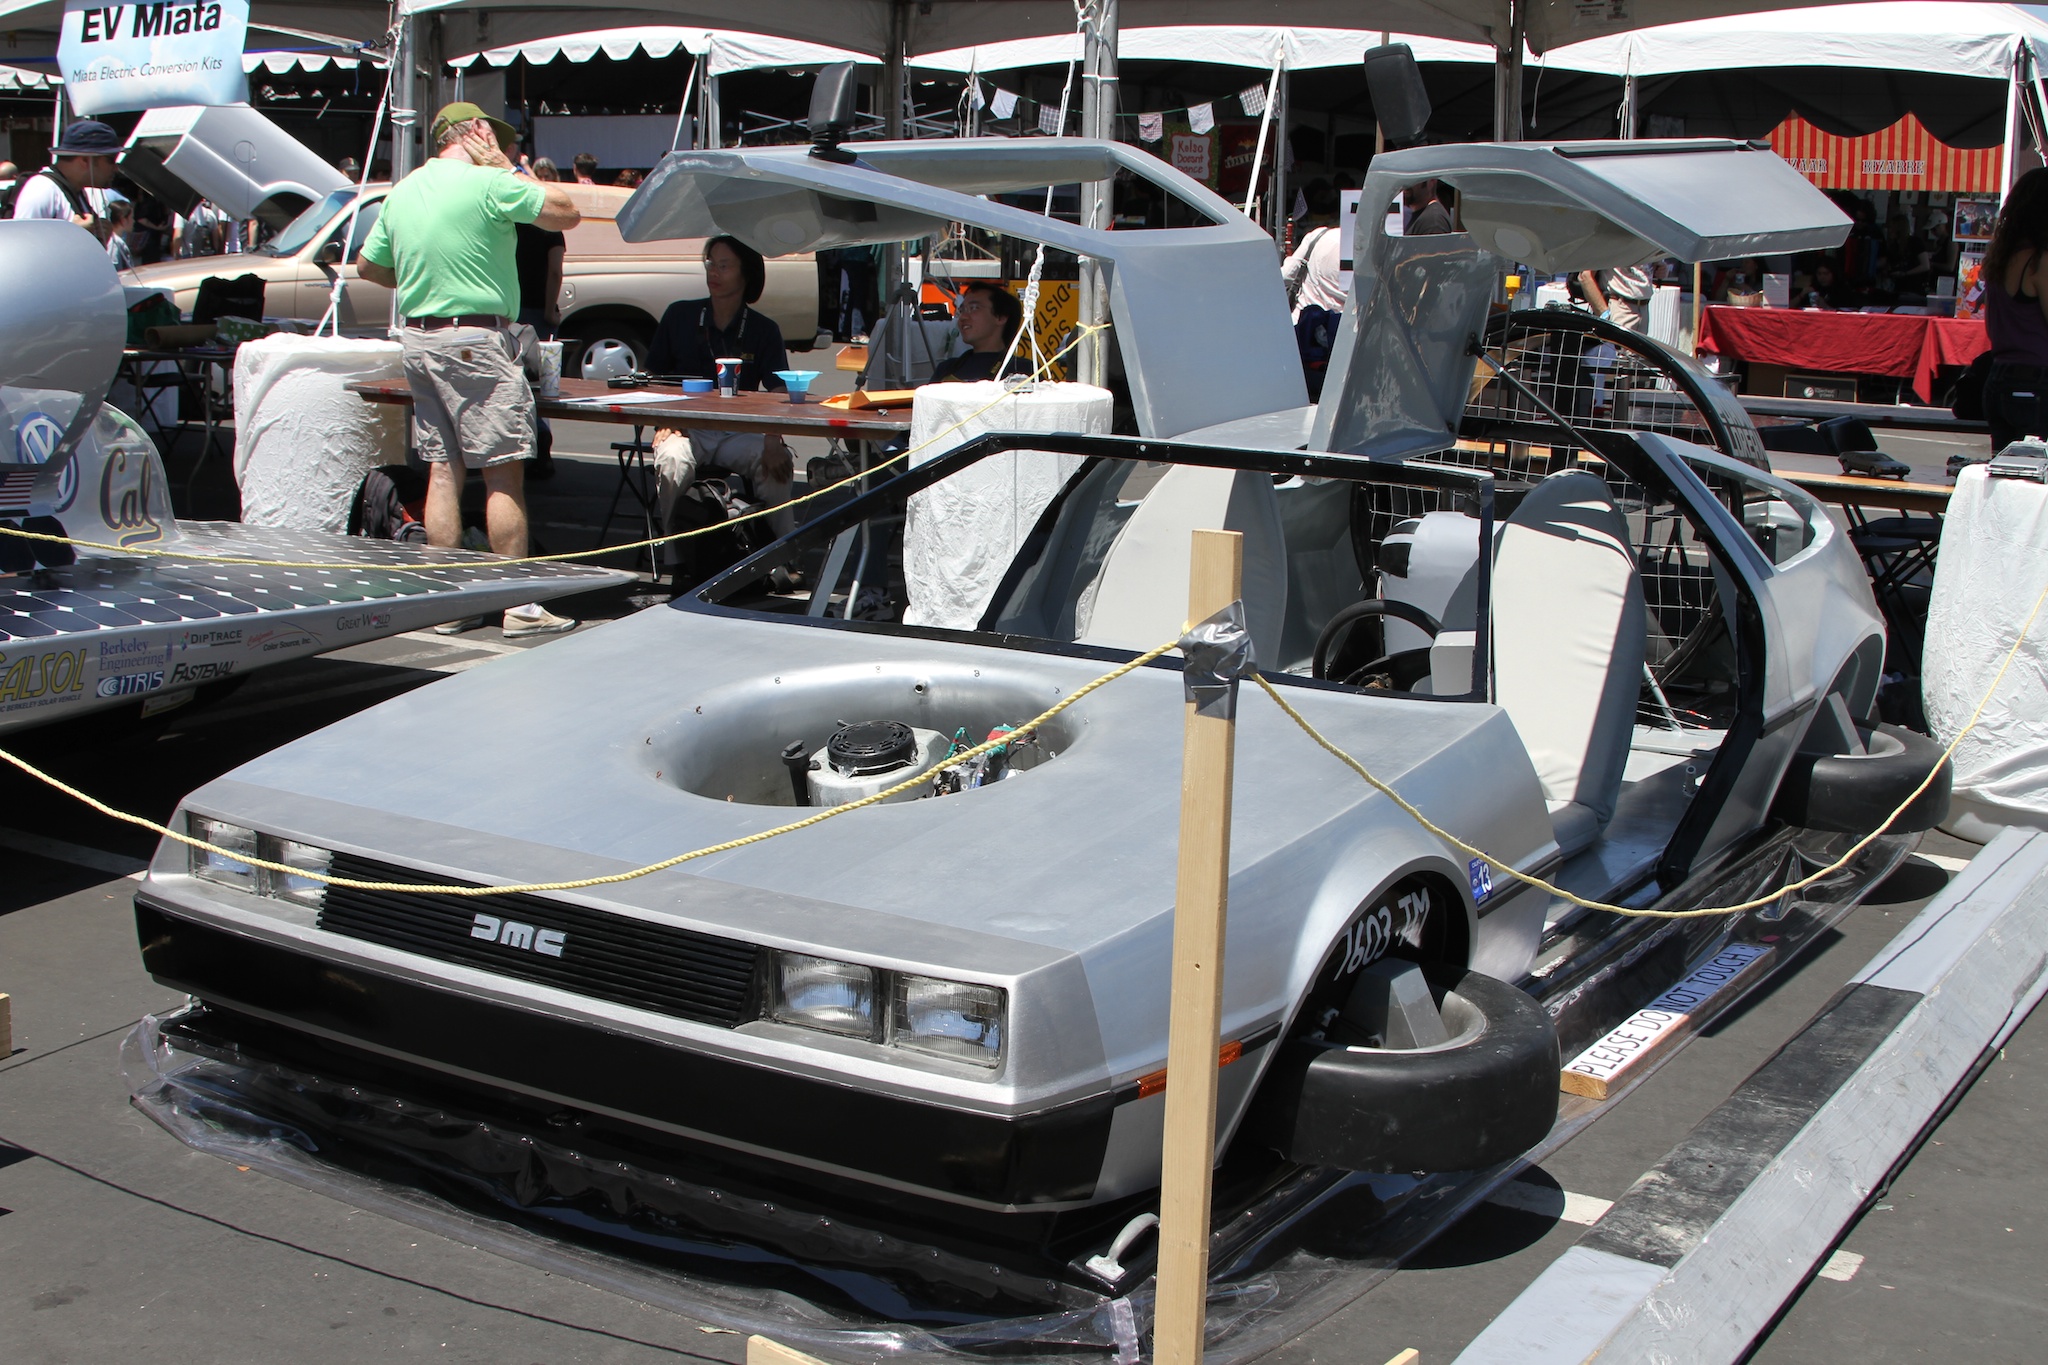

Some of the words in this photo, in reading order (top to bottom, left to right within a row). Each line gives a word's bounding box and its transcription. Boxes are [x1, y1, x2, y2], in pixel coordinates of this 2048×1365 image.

[81, 5, 124, 43] EV
[131, 0, 222, 38] Miata
[72, 69, 98, 83] Miata
[100, 64, 137, 80] Electric
[140, 59, 198, 77] Conversion
[201, 56, 222, 71] Kits
[1177, 140, 1203, 153] Kelso
[1782, 157, 1828, 173] ZAAR
[1861, 159, 1925, 175] BIZARRE
[1042, 319, 1071, 359] SIGH
[100, 447, 163, 548] Cal
[99, 637, 149, 656] Berkeley
[263, 642, 279, 652] Color
[98, 653, 165, 673] Engineering
[6, 700, 37, 713] BERKELEY
[37, 696, 57, 708] SOLAR
[58, 693, 82, 704] VEHICLE
[1478, 862, 1493, 893] 13
[470, 913, 568, 958] DMC
[1571, 1029, 1649, 1078] PLEASE
[1627, 1010, 1672, 1031] DO
[1653, 986, 1706, 1012] NOT
[1686, 952, 1753, 986] TOUCH
